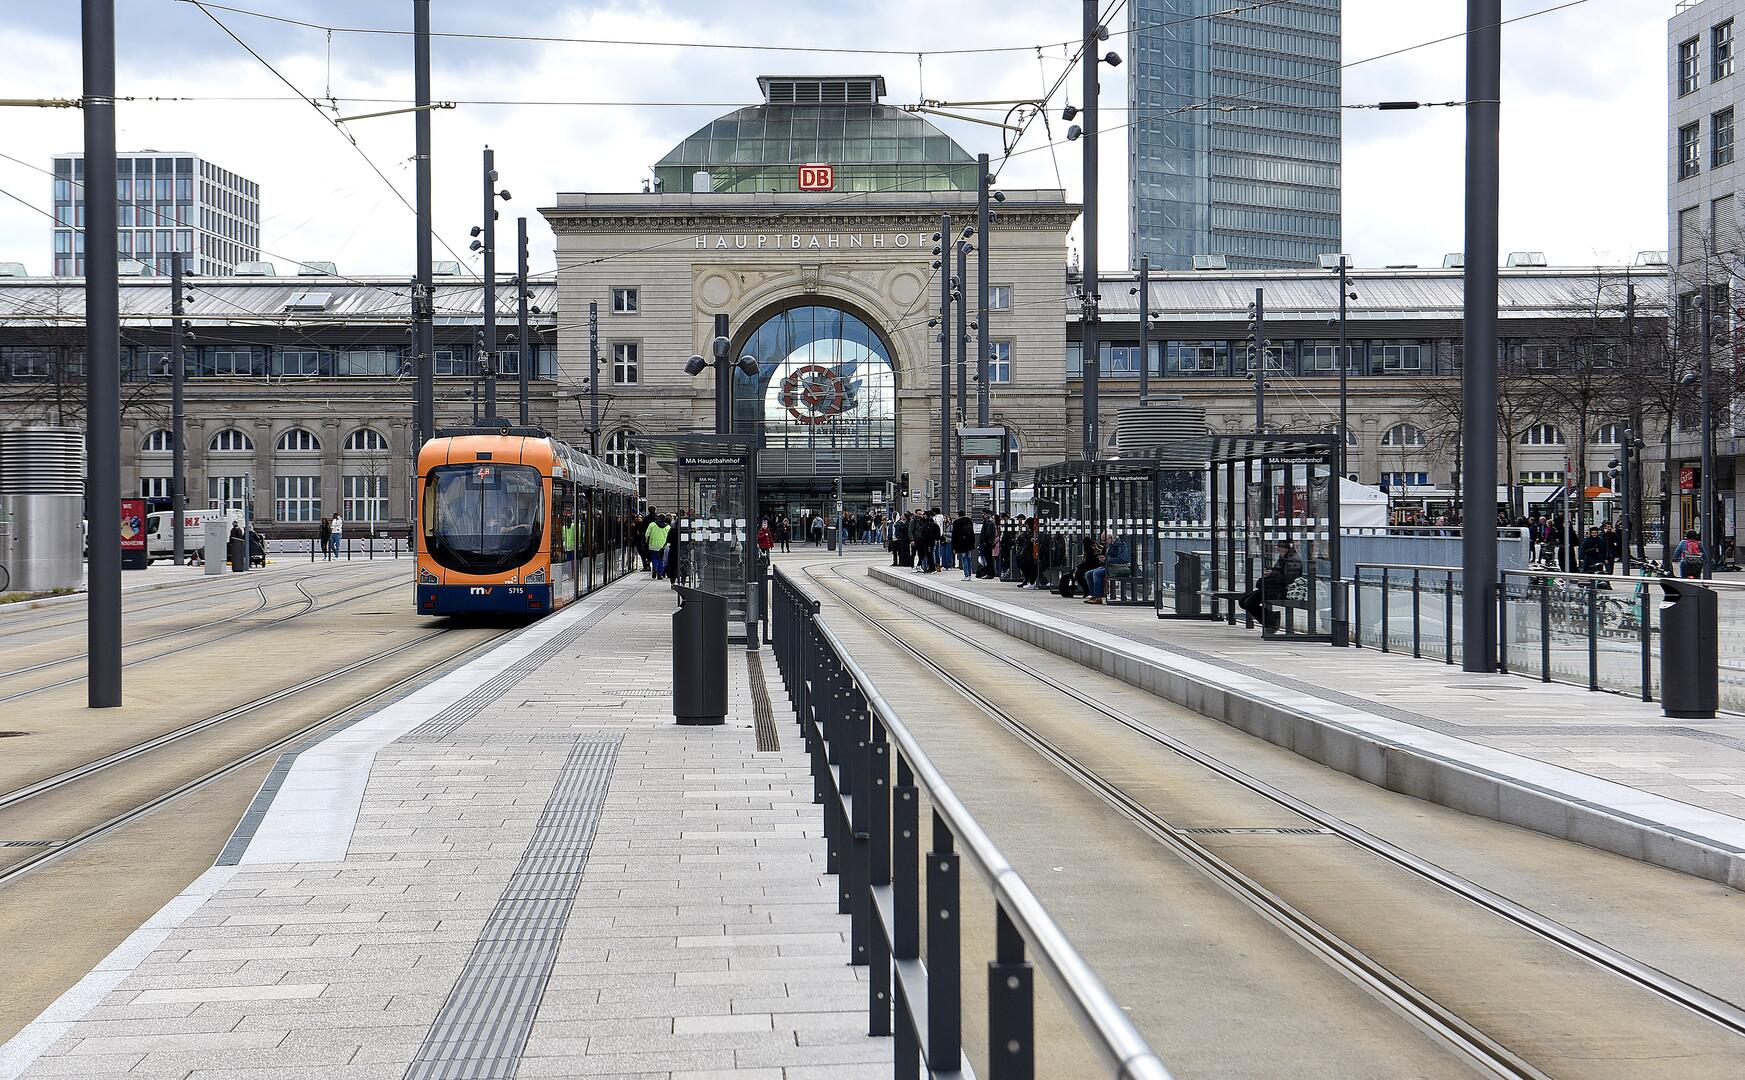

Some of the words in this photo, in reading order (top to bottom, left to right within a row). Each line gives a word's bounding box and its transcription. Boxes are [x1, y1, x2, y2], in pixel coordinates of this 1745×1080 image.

[802, 169, 830, 187] DB
[695, 233, 927, 250] HAUPTBAHNHOF
[697, 457, 740, 465] Hauptbahnhof
[470, 586, 493, 595] rnv
